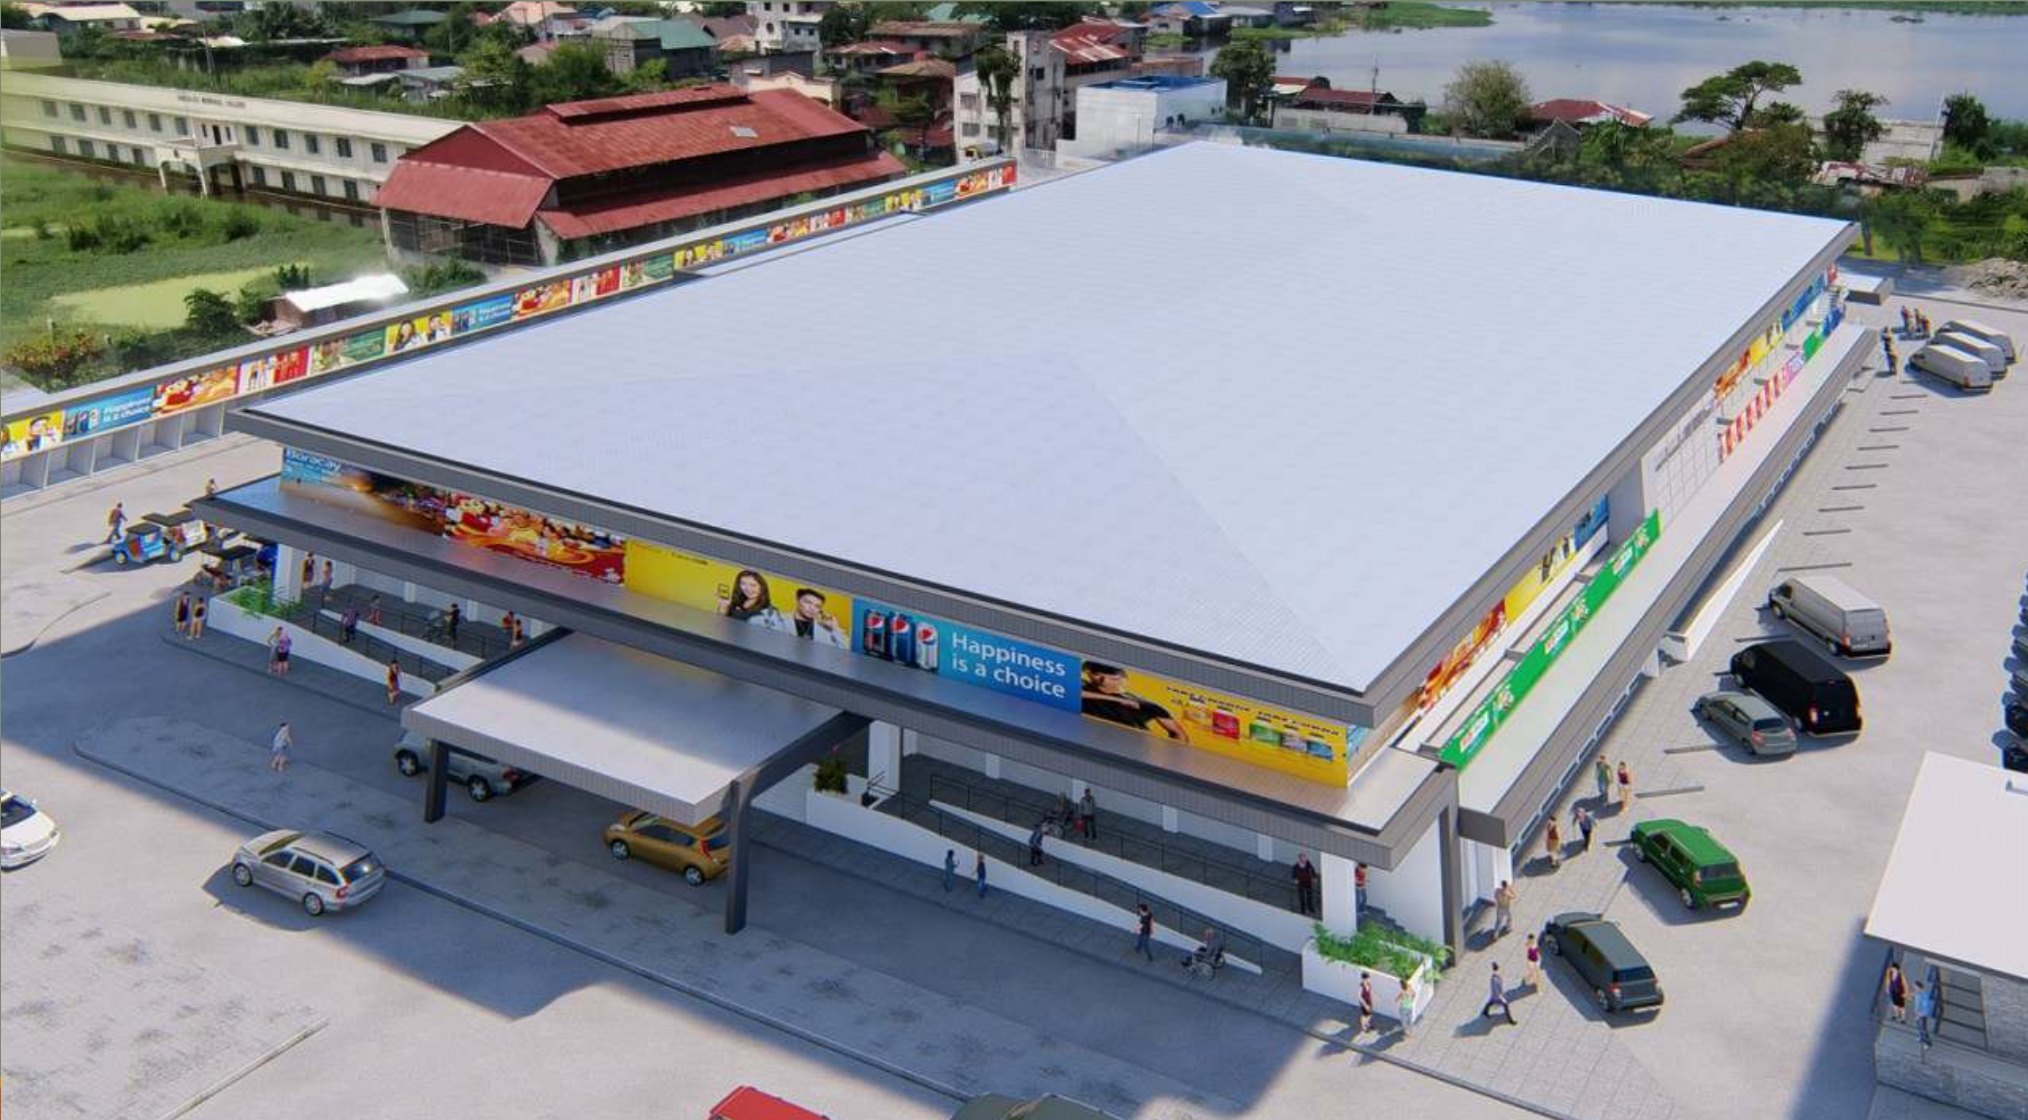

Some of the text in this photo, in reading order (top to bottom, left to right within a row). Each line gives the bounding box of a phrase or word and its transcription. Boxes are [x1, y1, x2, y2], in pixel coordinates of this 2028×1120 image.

[952, 632, 1066, 677] Happiness
[952, 653, 1066, 699] is a choice
